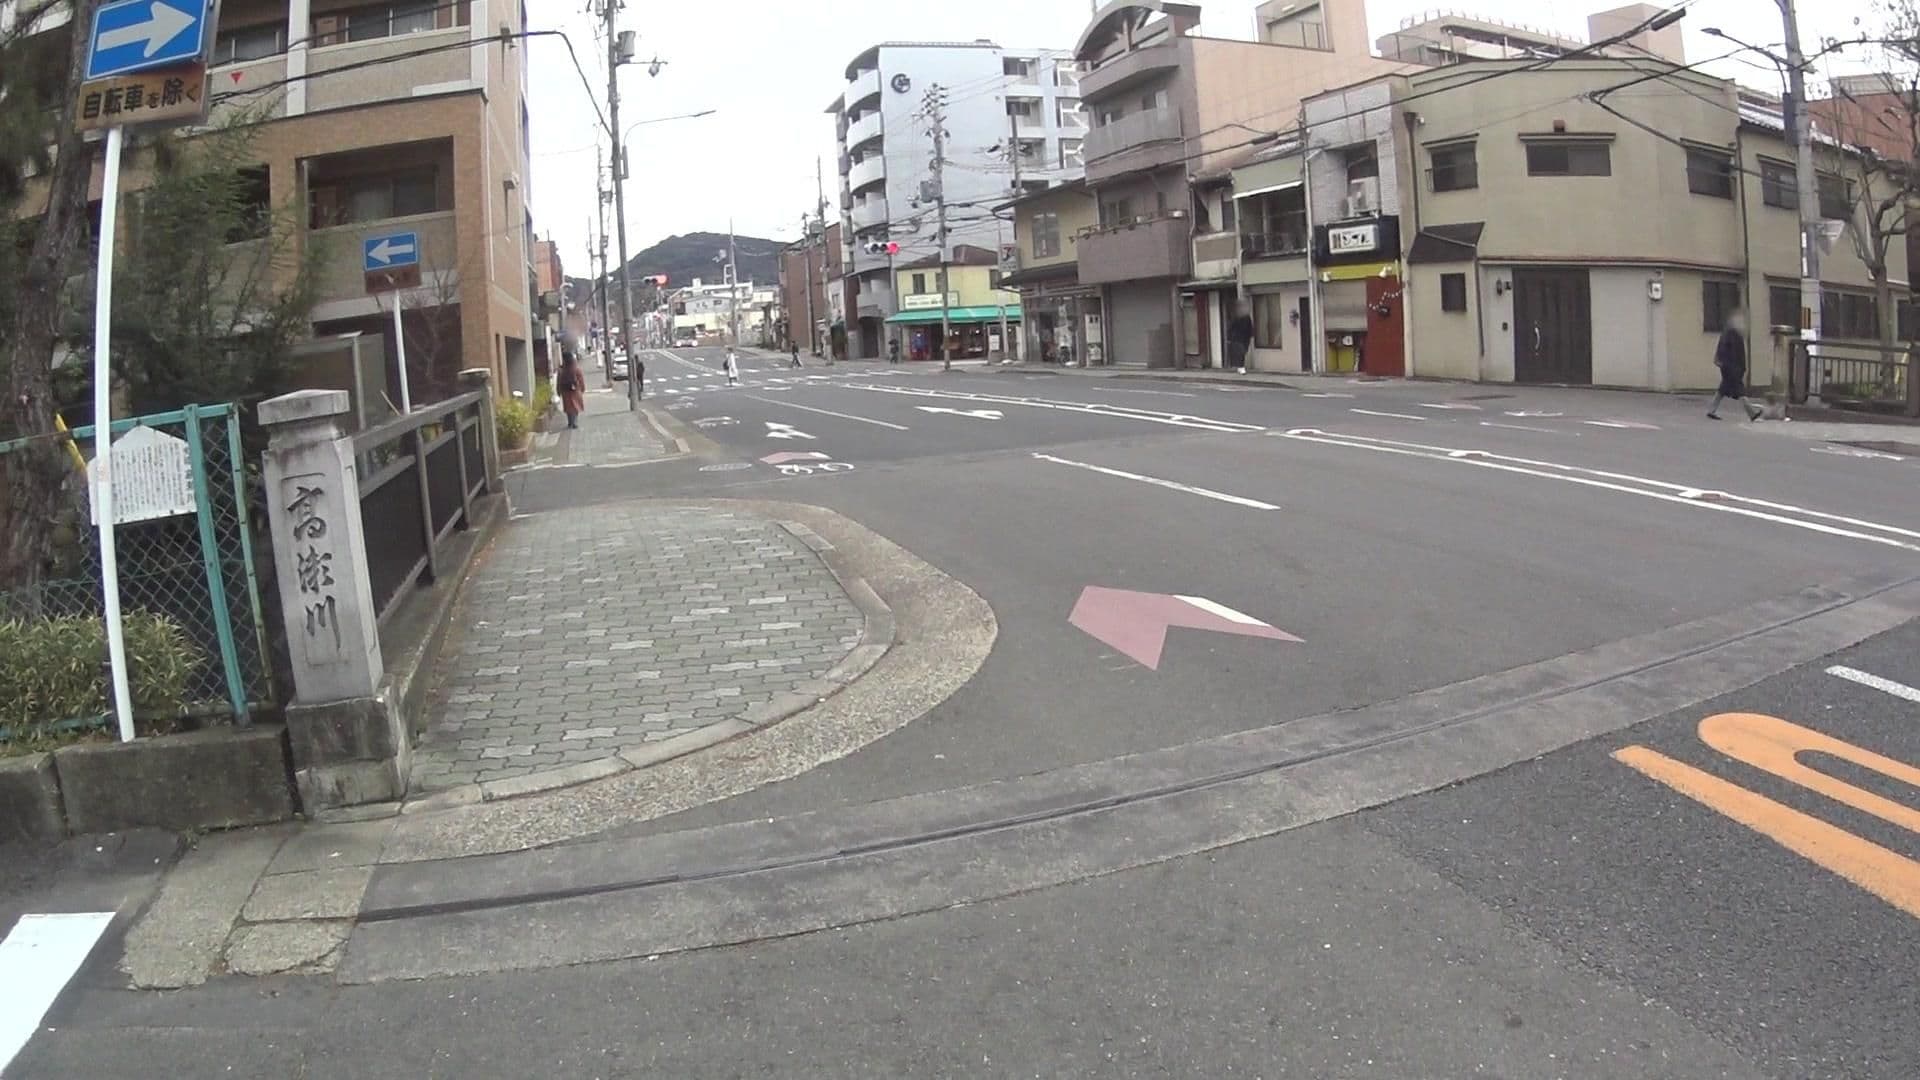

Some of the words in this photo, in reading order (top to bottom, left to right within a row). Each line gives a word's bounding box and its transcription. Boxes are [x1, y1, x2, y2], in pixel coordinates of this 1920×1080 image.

[84, 78, 199, 118] 自転車を除く
[287, 485, 341, 653] 高瀬川
